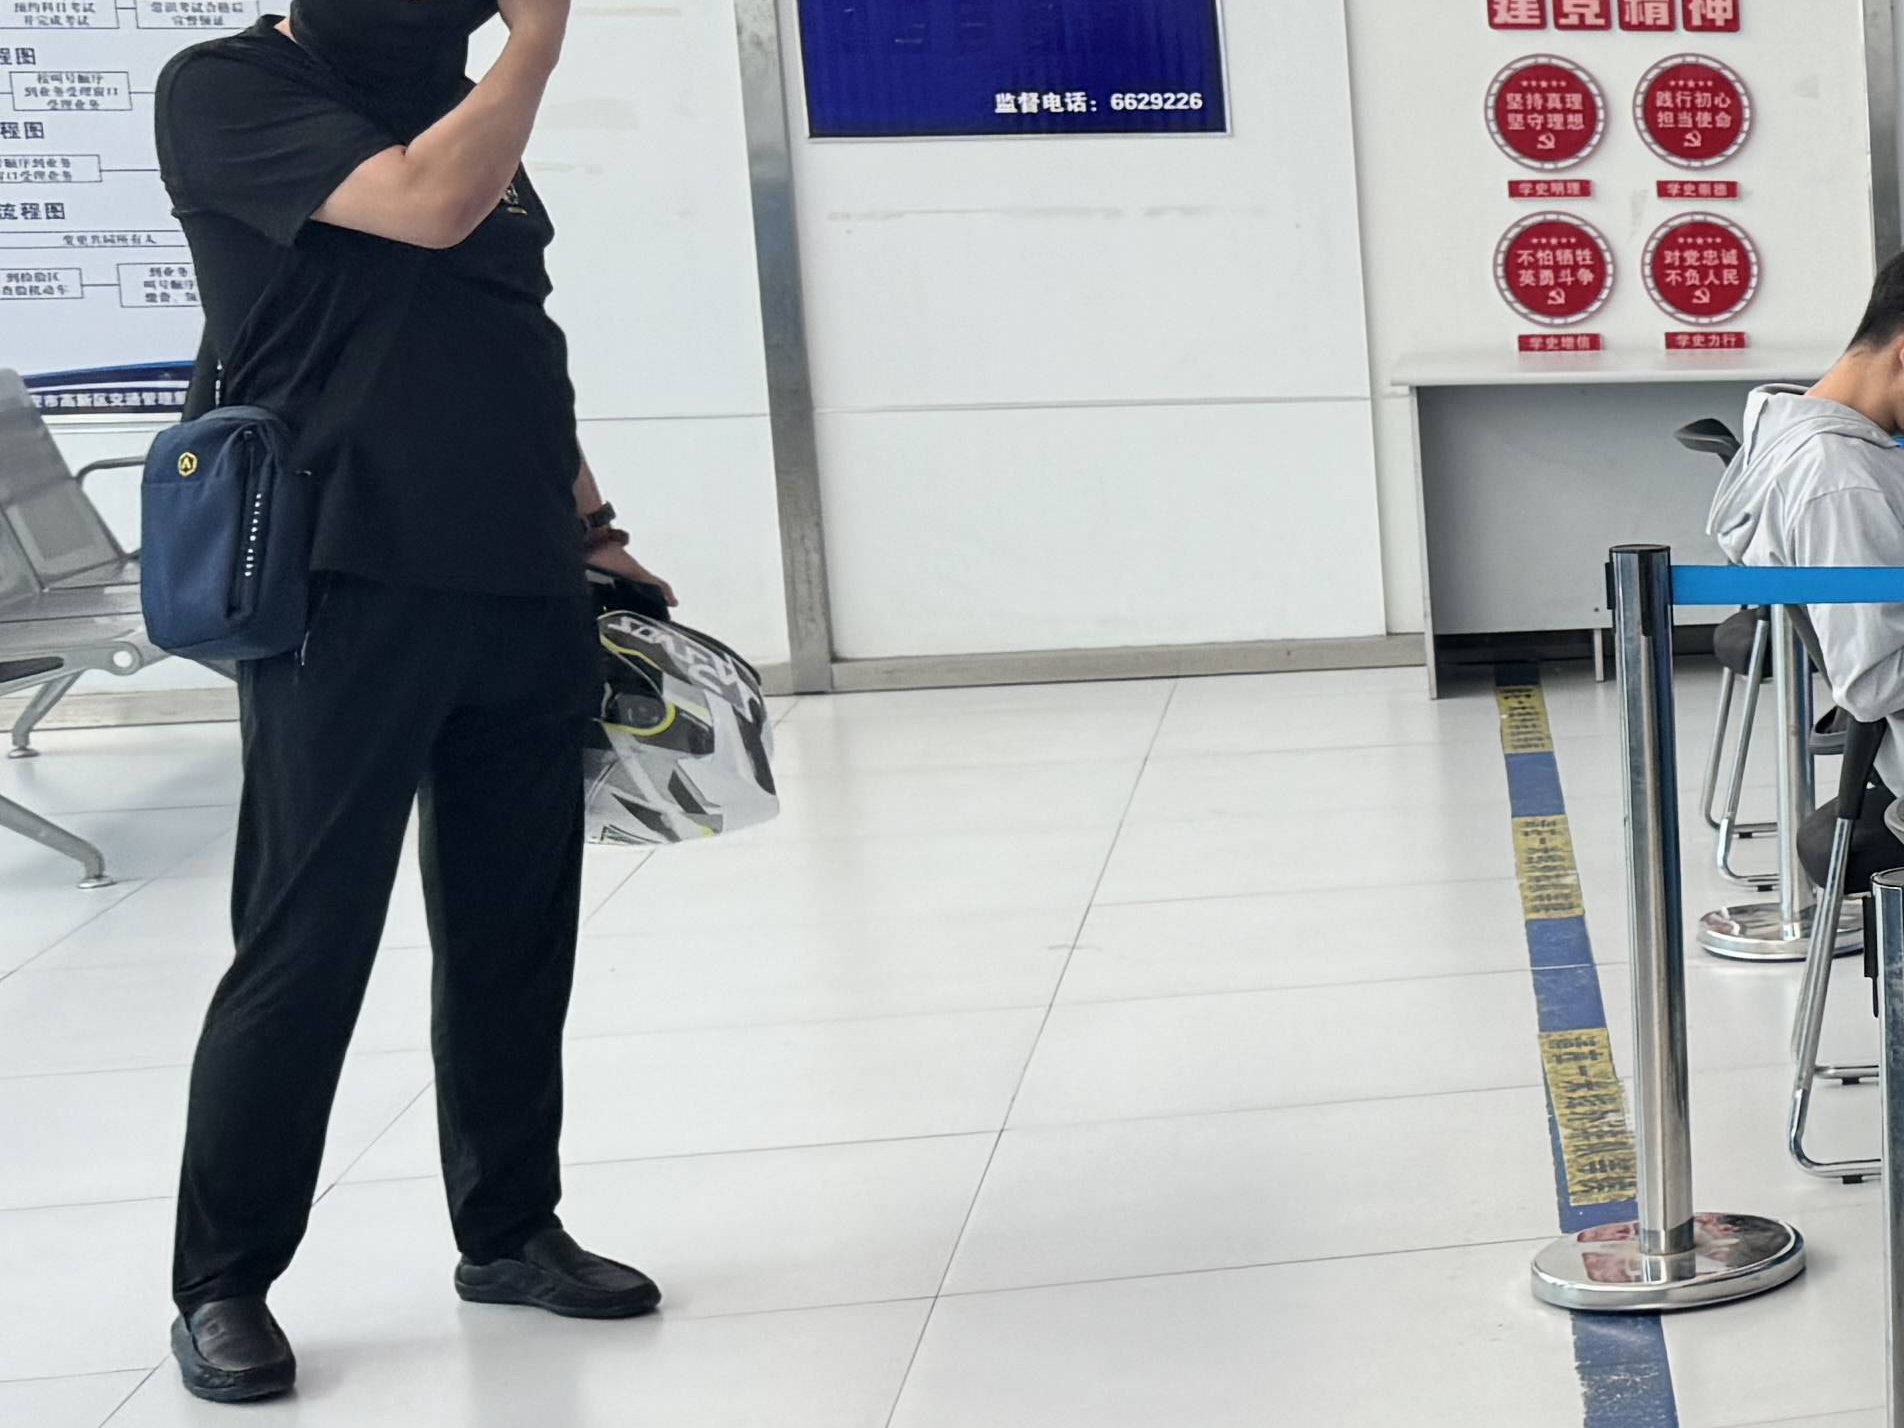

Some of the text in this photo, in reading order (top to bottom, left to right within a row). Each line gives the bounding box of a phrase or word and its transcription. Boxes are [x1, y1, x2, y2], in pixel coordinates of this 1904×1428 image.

[1505, 92, 1584, 112] 坚持真理
[1655, 90, 1733, 110] 践行初心
[1506, 112, 1586, 132] 坚守理想
[1656, 111, 1734, 130] 担当使命
[1515, 248, 1596, 268] 不怕牺牲
[1663, 247, 1740, 267] 对党忠诚
[1517, 268, 1596, 287] 英勇斗争
[1665, 267, 1741, 287] 不负人民
